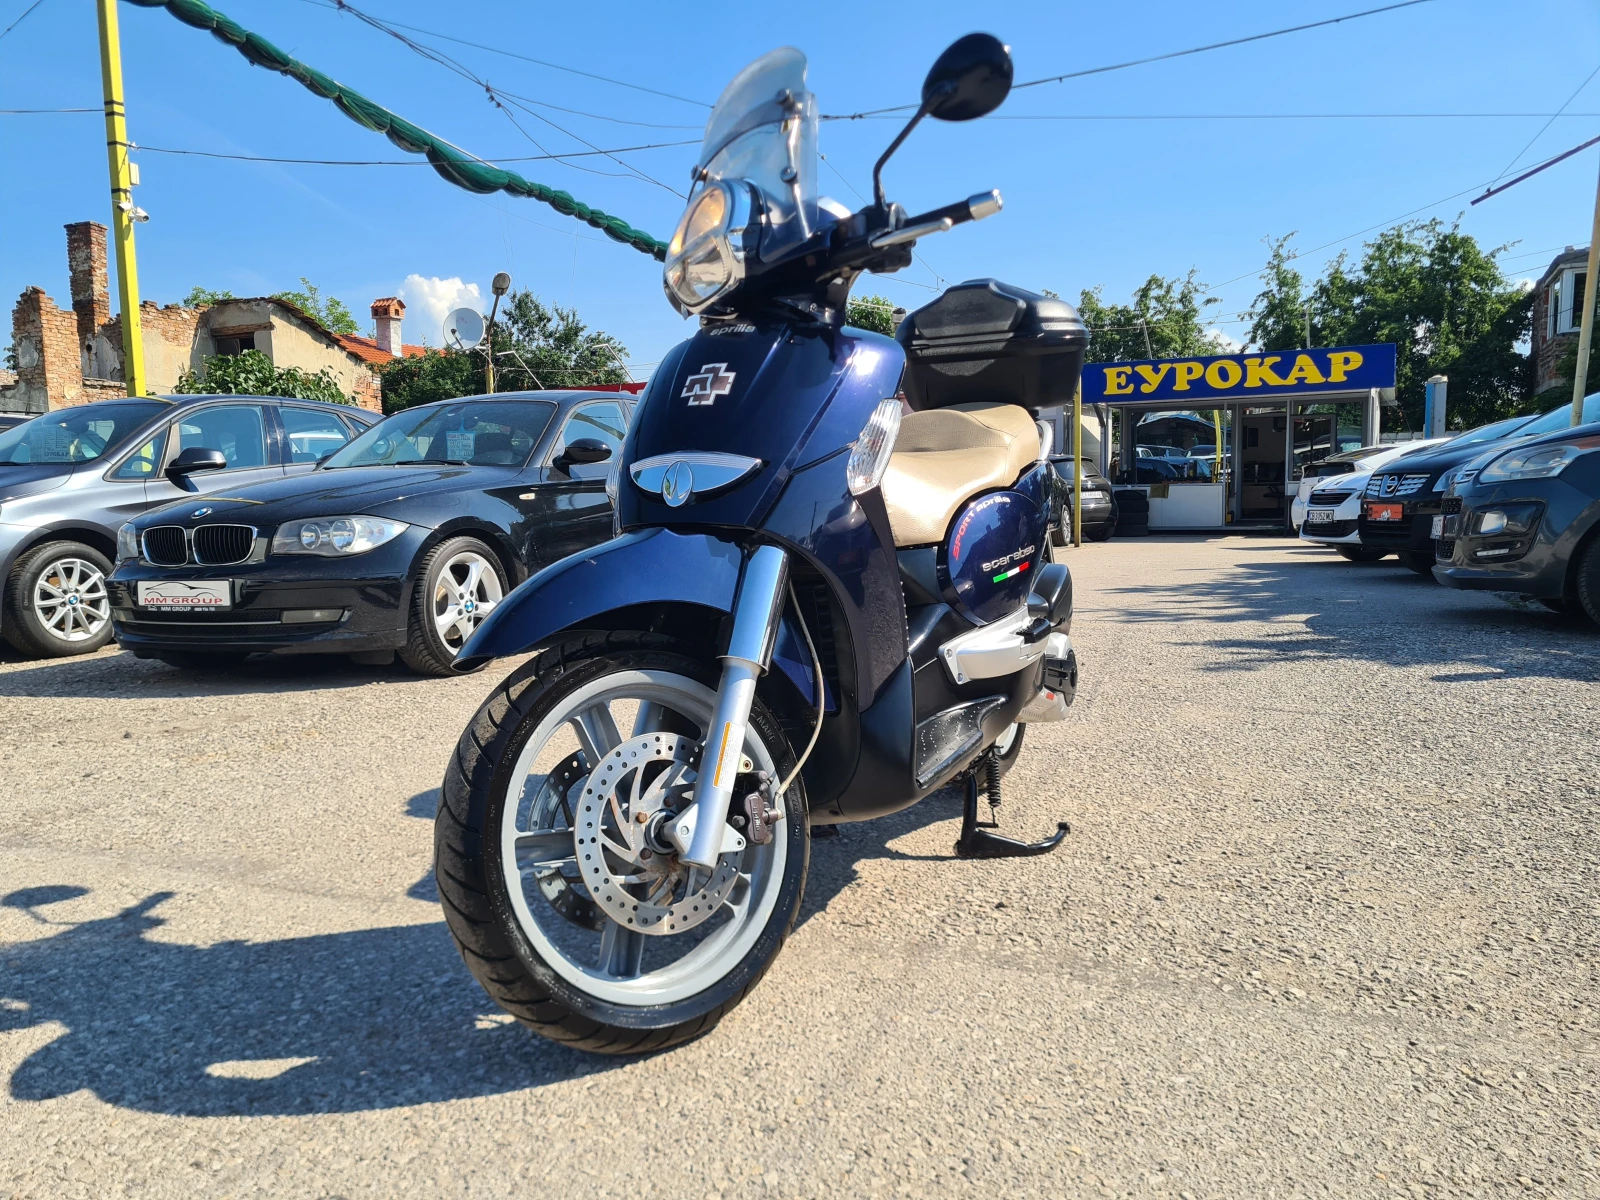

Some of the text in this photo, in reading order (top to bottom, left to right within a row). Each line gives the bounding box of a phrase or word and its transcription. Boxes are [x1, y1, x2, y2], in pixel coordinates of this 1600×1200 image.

[709, 324, 756, 336] aprilia
[1103, 351, 1364, 396] ЕУРОКАР
[952, 495, 1011, 561] SPORT aprilia
[982, 545, 1035, 572] scarabeo
